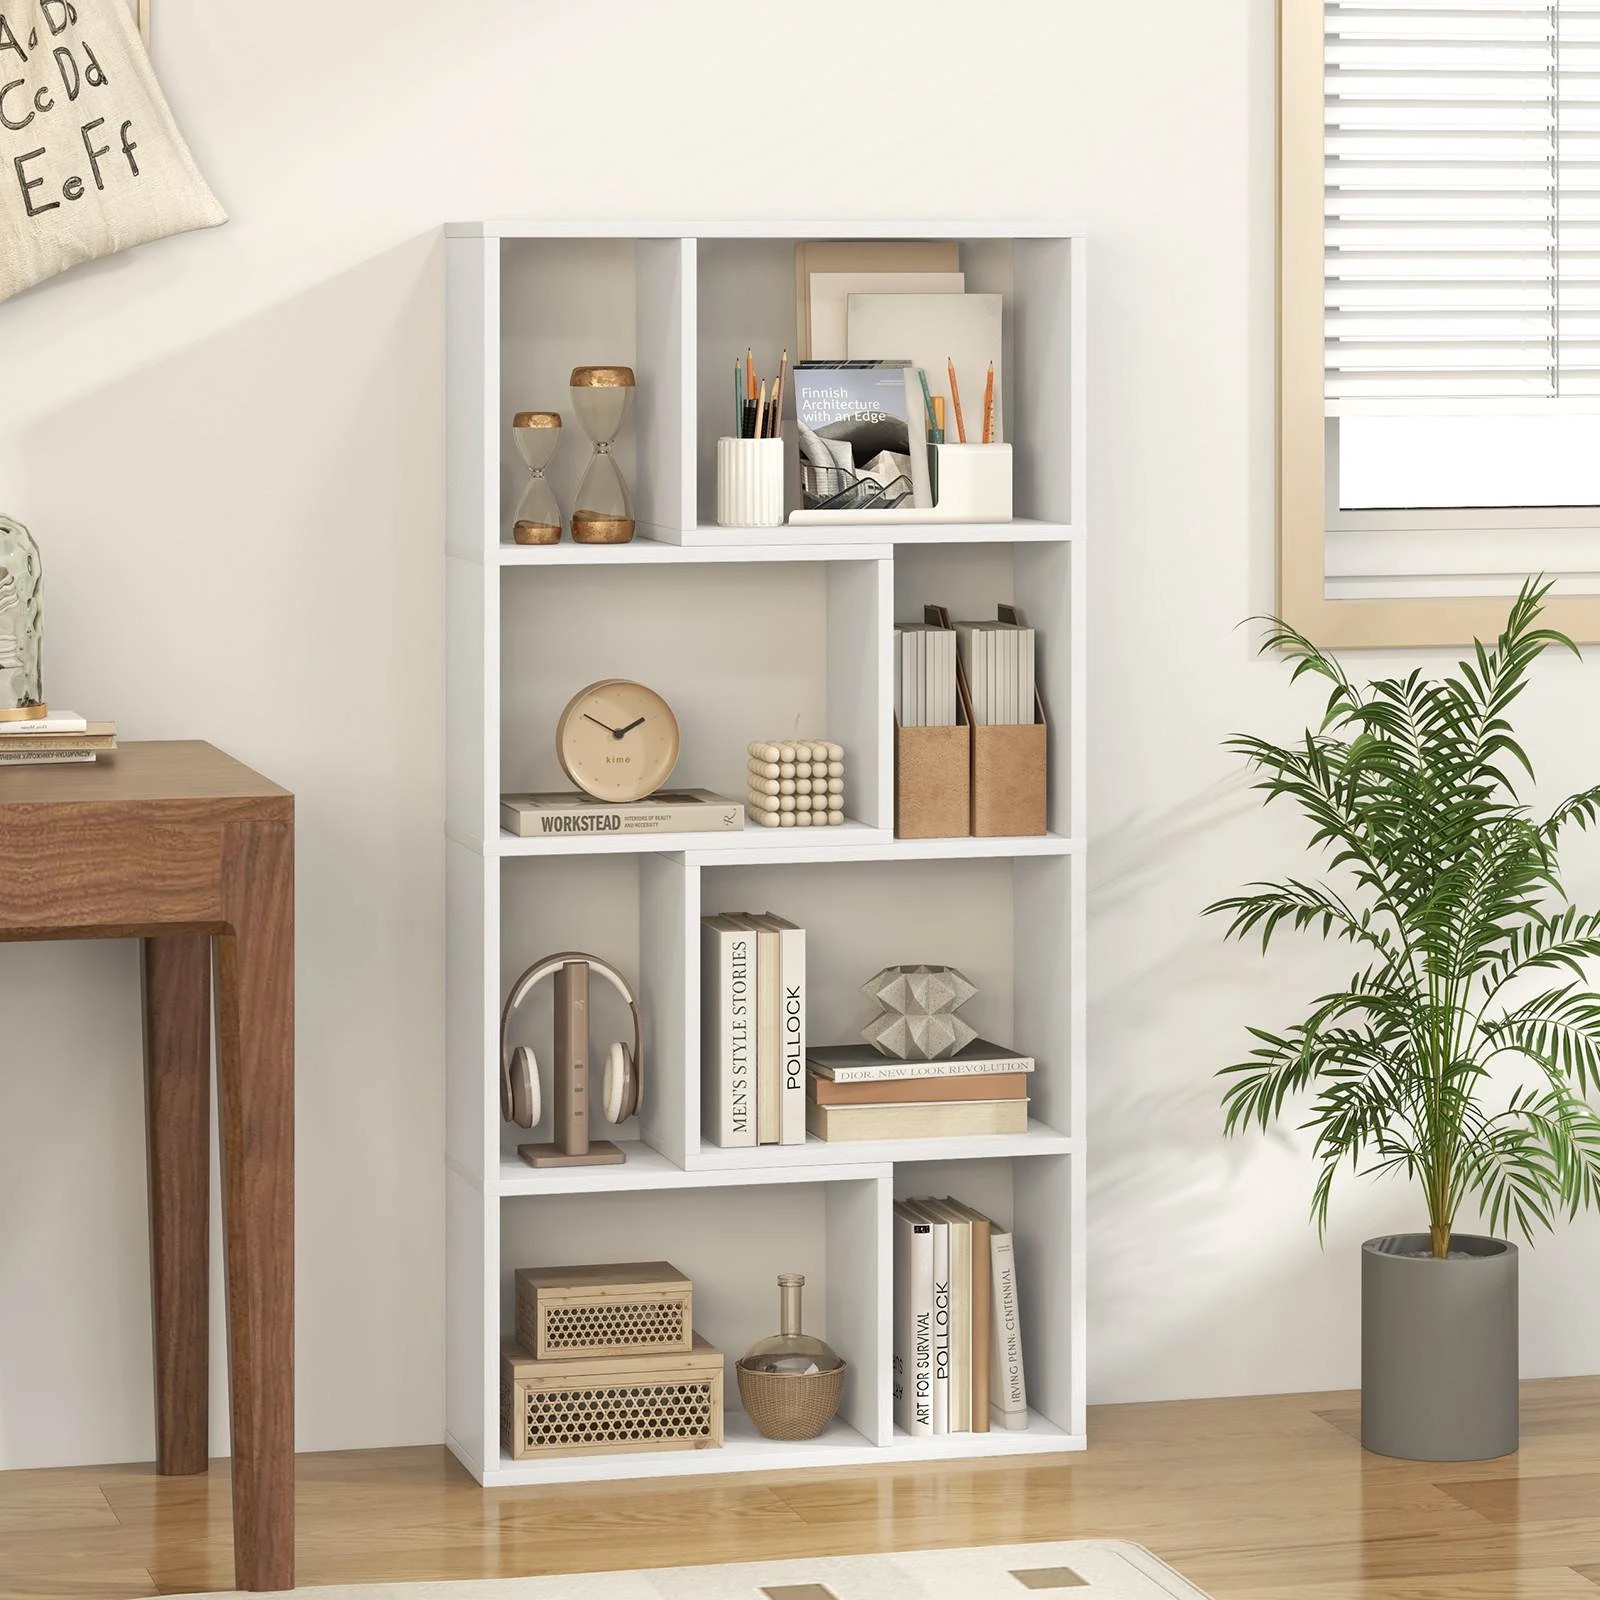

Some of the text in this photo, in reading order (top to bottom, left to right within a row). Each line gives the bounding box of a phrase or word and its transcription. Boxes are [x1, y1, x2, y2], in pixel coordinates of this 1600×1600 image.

[802, 387, 848, 398] Finnish
[802, 400, 881, 410] Architecture
[803, 411, 886, 424] with an Edge
[541, 815, 621, 832] WORKSTEAD
[732, 941, 747, 1015] STORIES
[732, 1020, 747, 1075] STYLE
[787, 985, 801, 1090] POLLOCK
[878, 1069, 907, 1078] NEW
[911, 1066, 945, 1076] LOOK
[949, 1061, 1029, 1074] REVOLUTION
[1002, 1269, 1015, 1331] CENTENNIAL
[936, 1281, 949, 1380] POLLOCK
[917, 1312, 930, 1425] ART FOR SURVIVAL
[1009, 1365, 1021, 1402] IRVING
